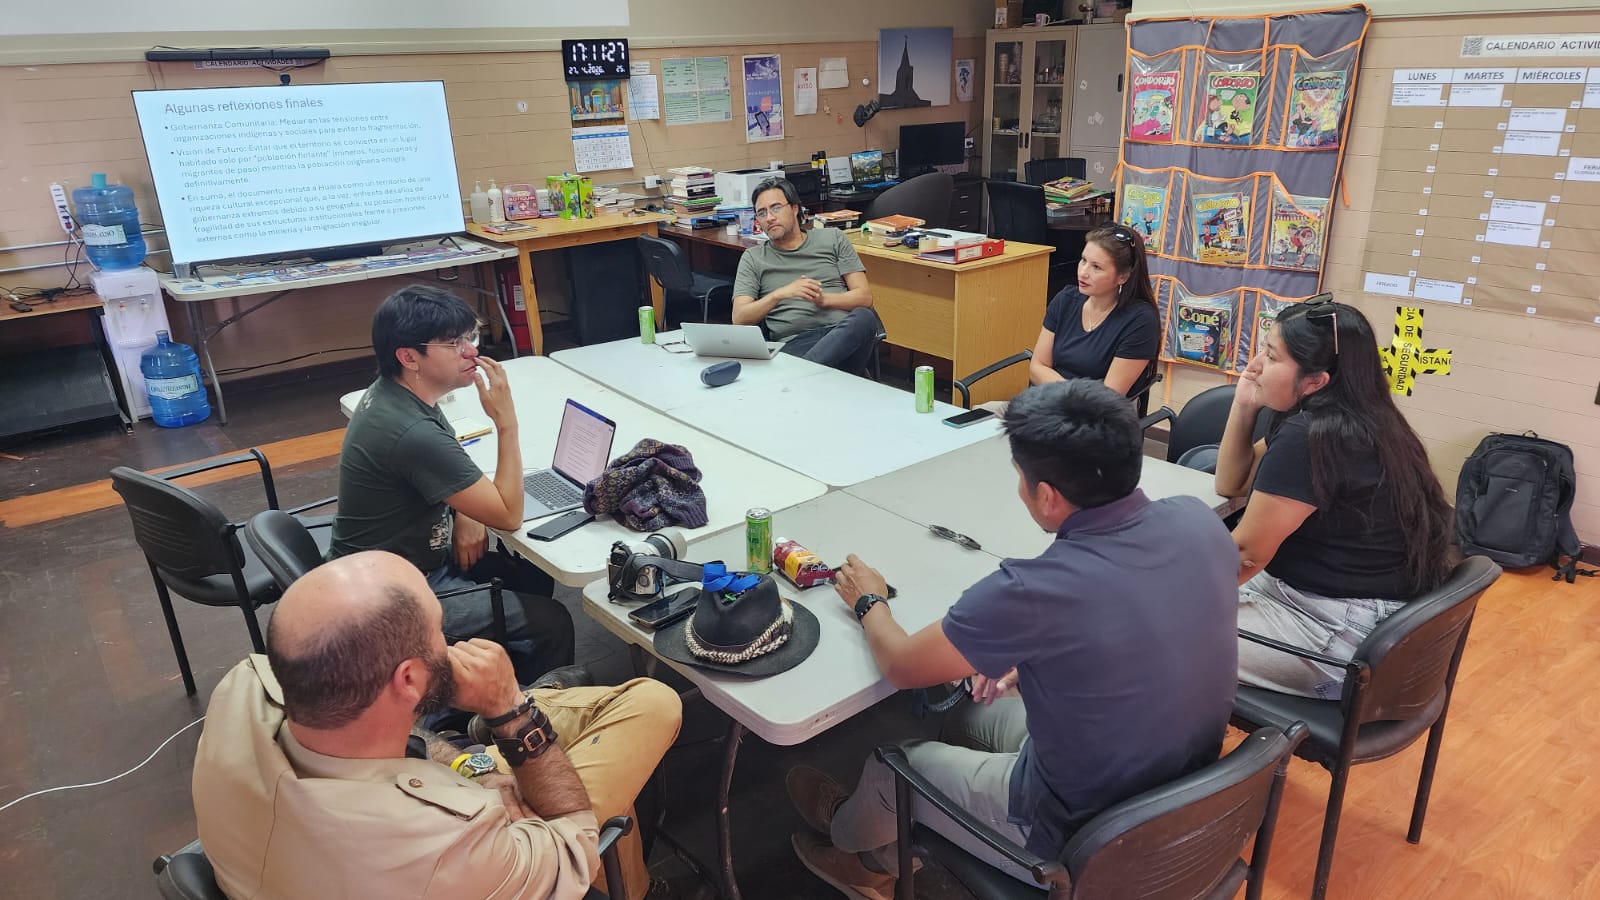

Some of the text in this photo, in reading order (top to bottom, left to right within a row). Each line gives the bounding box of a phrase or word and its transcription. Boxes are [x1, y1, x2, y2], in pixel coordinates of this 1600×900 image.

[1486, 41, 1555, 50] CALENDARIO
[572, 42, 624, 62] 17:11:27
[1408, 72, 1437, 80] LUNES
[1464, 72, 1504, 80] MARTES
[1522, 68, 1582, 80] MIÉRCOLES
[1134, 76, 1175, 86] CONDORITO
[1212, 76, 1255, 88] CONDORITO
[163, 96, 323, 116] Algunas reflexiones finales
[179, 158, 216, 166] habitado
[236, 187, 282, 197] documento
[1180, 306, 1219, 325] Coné
[1404, 326, 1414, 337] DE
[1396, 342, 1412, 390] SEGURIDAD
